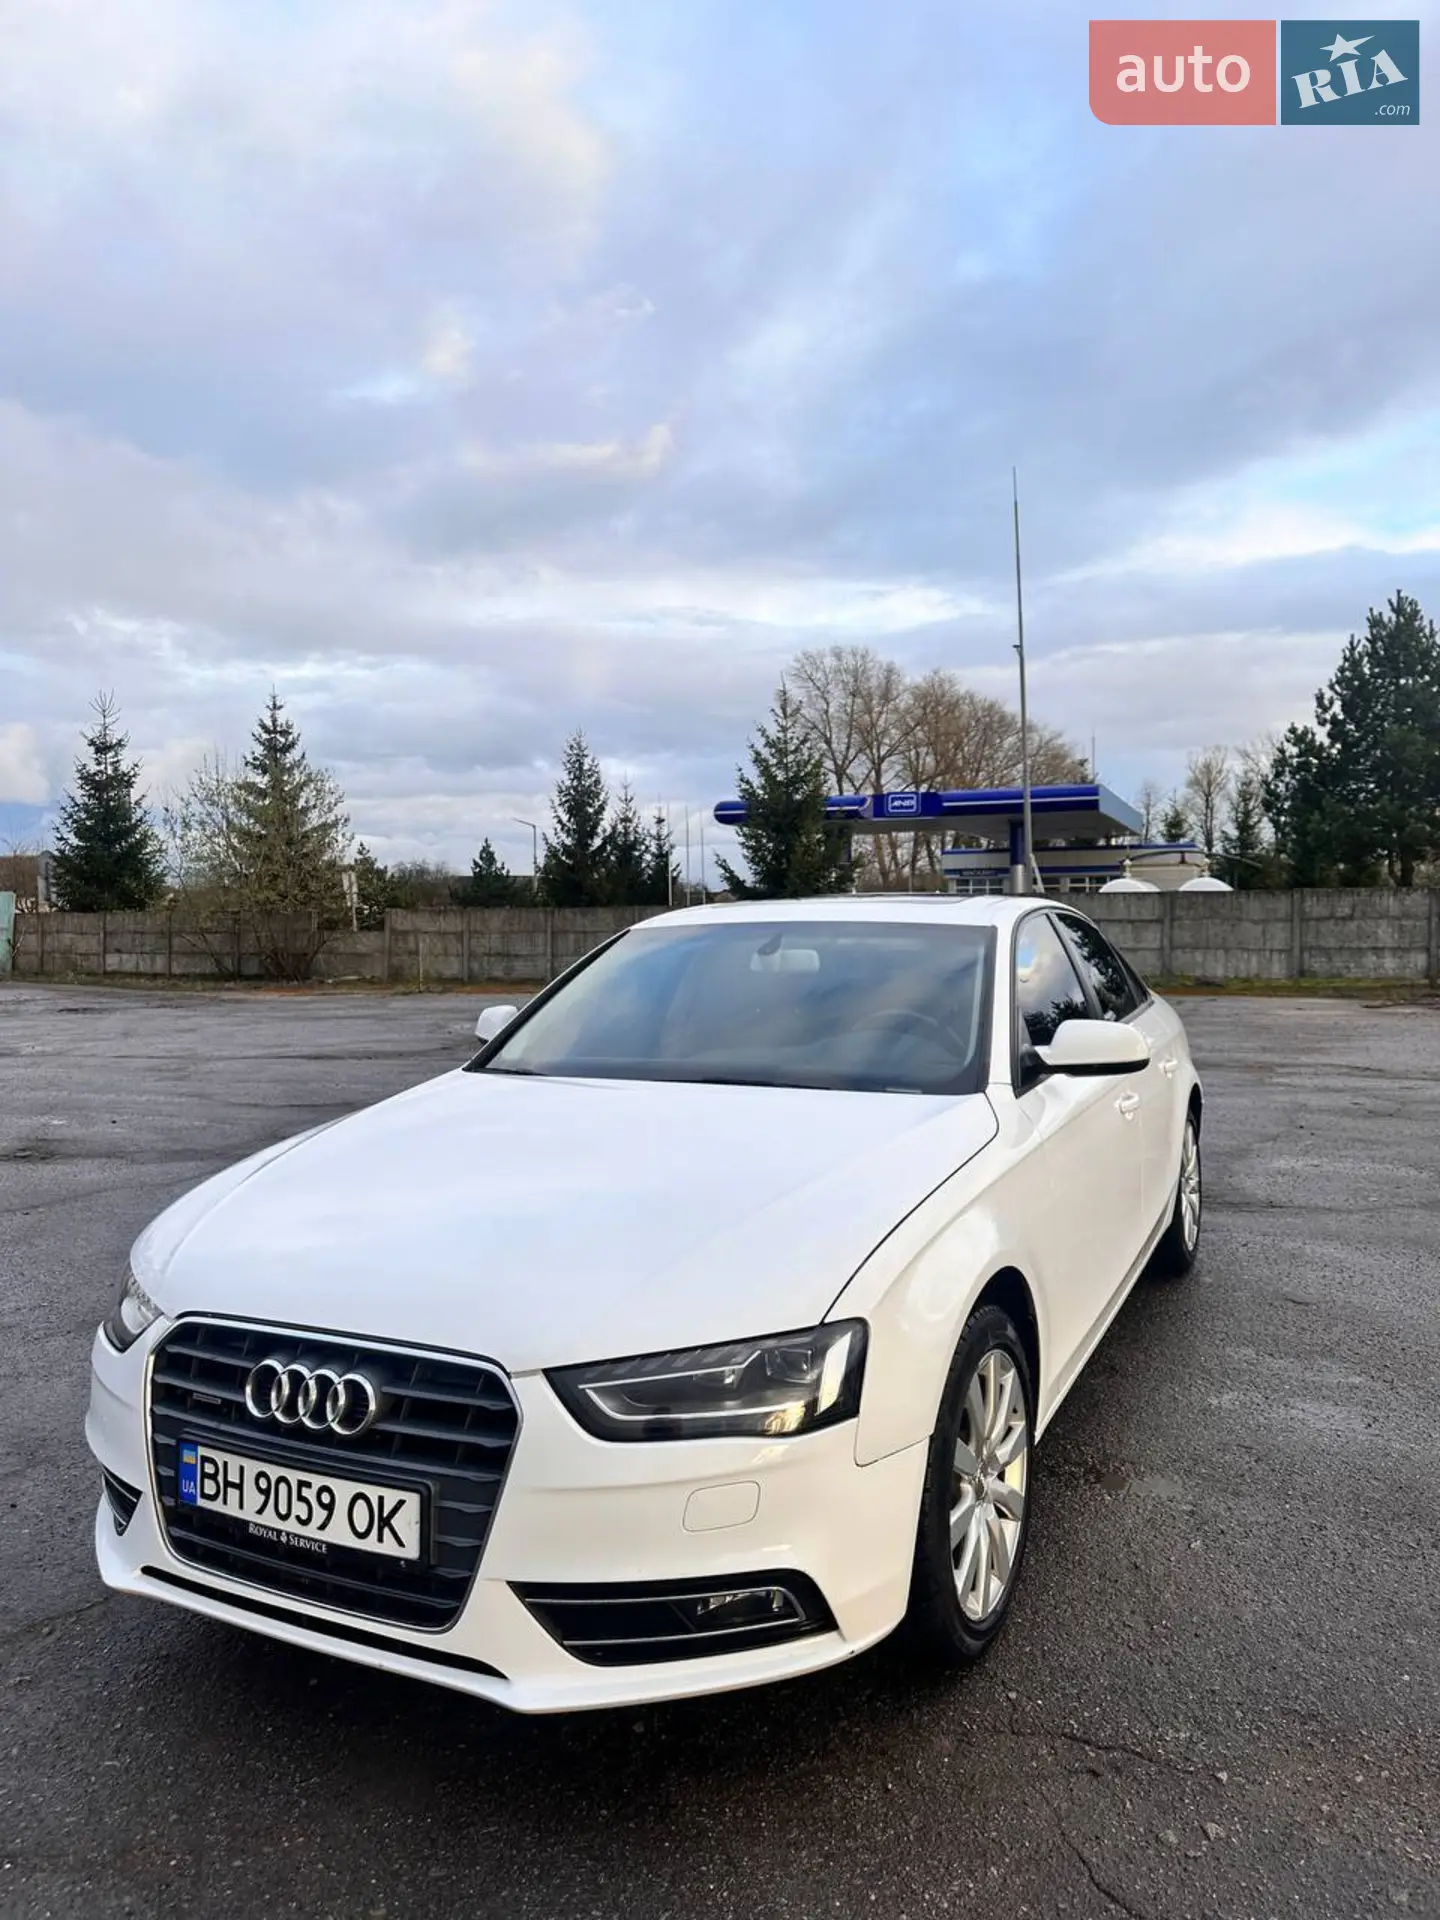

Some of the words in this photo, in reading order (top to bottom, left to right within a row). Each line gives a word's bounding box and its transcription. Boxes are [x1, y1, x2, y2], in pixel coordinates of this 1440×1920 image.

[182, 1478, 196, 1496] UA
[200, 1455, 245, 1510] BH
[254, 1470, 336, 1531] 9059
[348, 1491, 407, 1549] OK
[248, 1522, 278, 1541] ROYAL
[289, 1534, 328, 1555] SERVICE
